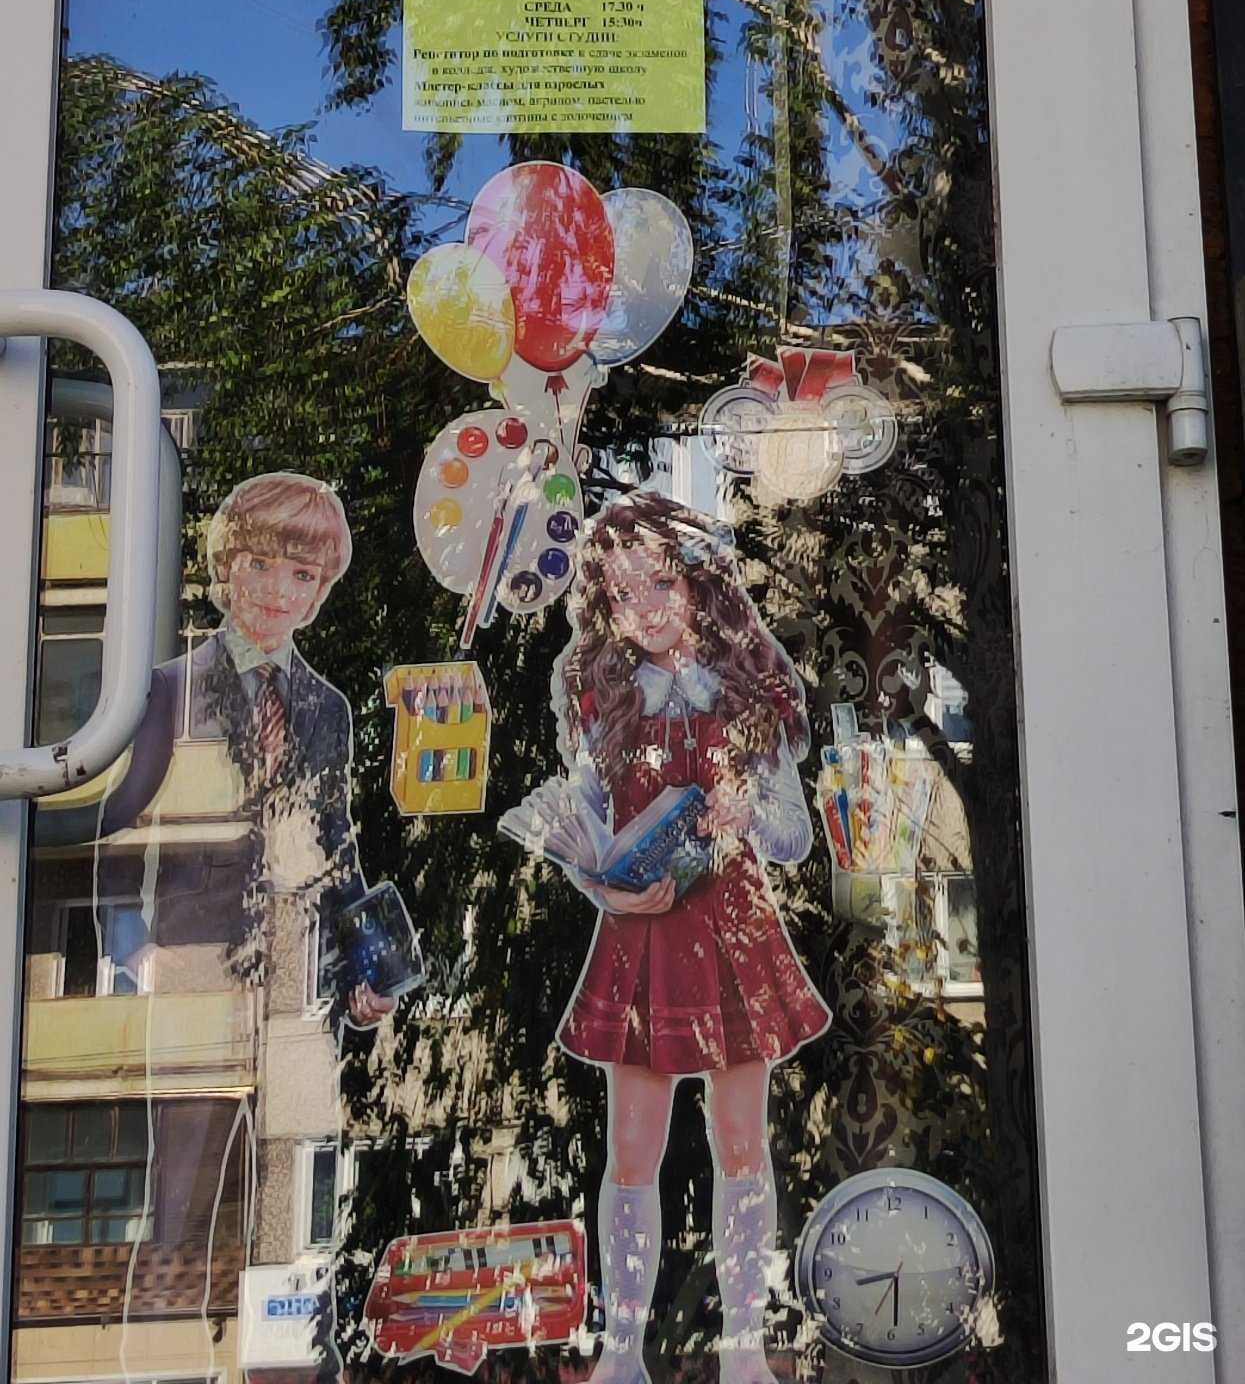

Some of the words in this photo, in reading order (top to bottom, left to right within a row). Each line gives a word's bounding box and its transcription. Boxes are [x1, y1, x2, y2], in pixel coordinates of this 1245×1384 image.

[524, 1, 572, 13] СРЕДА
[525, 16, 590, 28] ЧЕТВЕРГ
[496, 31, 553, 42] УСЛУГИ
[413, 48, 480, 61] Репетитор
[483, 50, 499, 58] по
[502, 49, 574, 59] подготовке
[589, 50, 622, 58] сдаче
[608, 65, 647, 76] школу
[415, 81, 514, 94] Мастер-классы
[544, 81, 605, 92] взрослых
[588, 97, 646, 106] пастелью
[887, 1196, 902, 1211] 12
[856, 1207, 869, 1222] 11
[830, 1231, 846, 1246] 10
[946, 1232, 956, 1247] 2
[824, 1267, 833, 1282] 9
[855, 1322, 864, 1335] 7
[887, 1328, 896, 1342] 6
